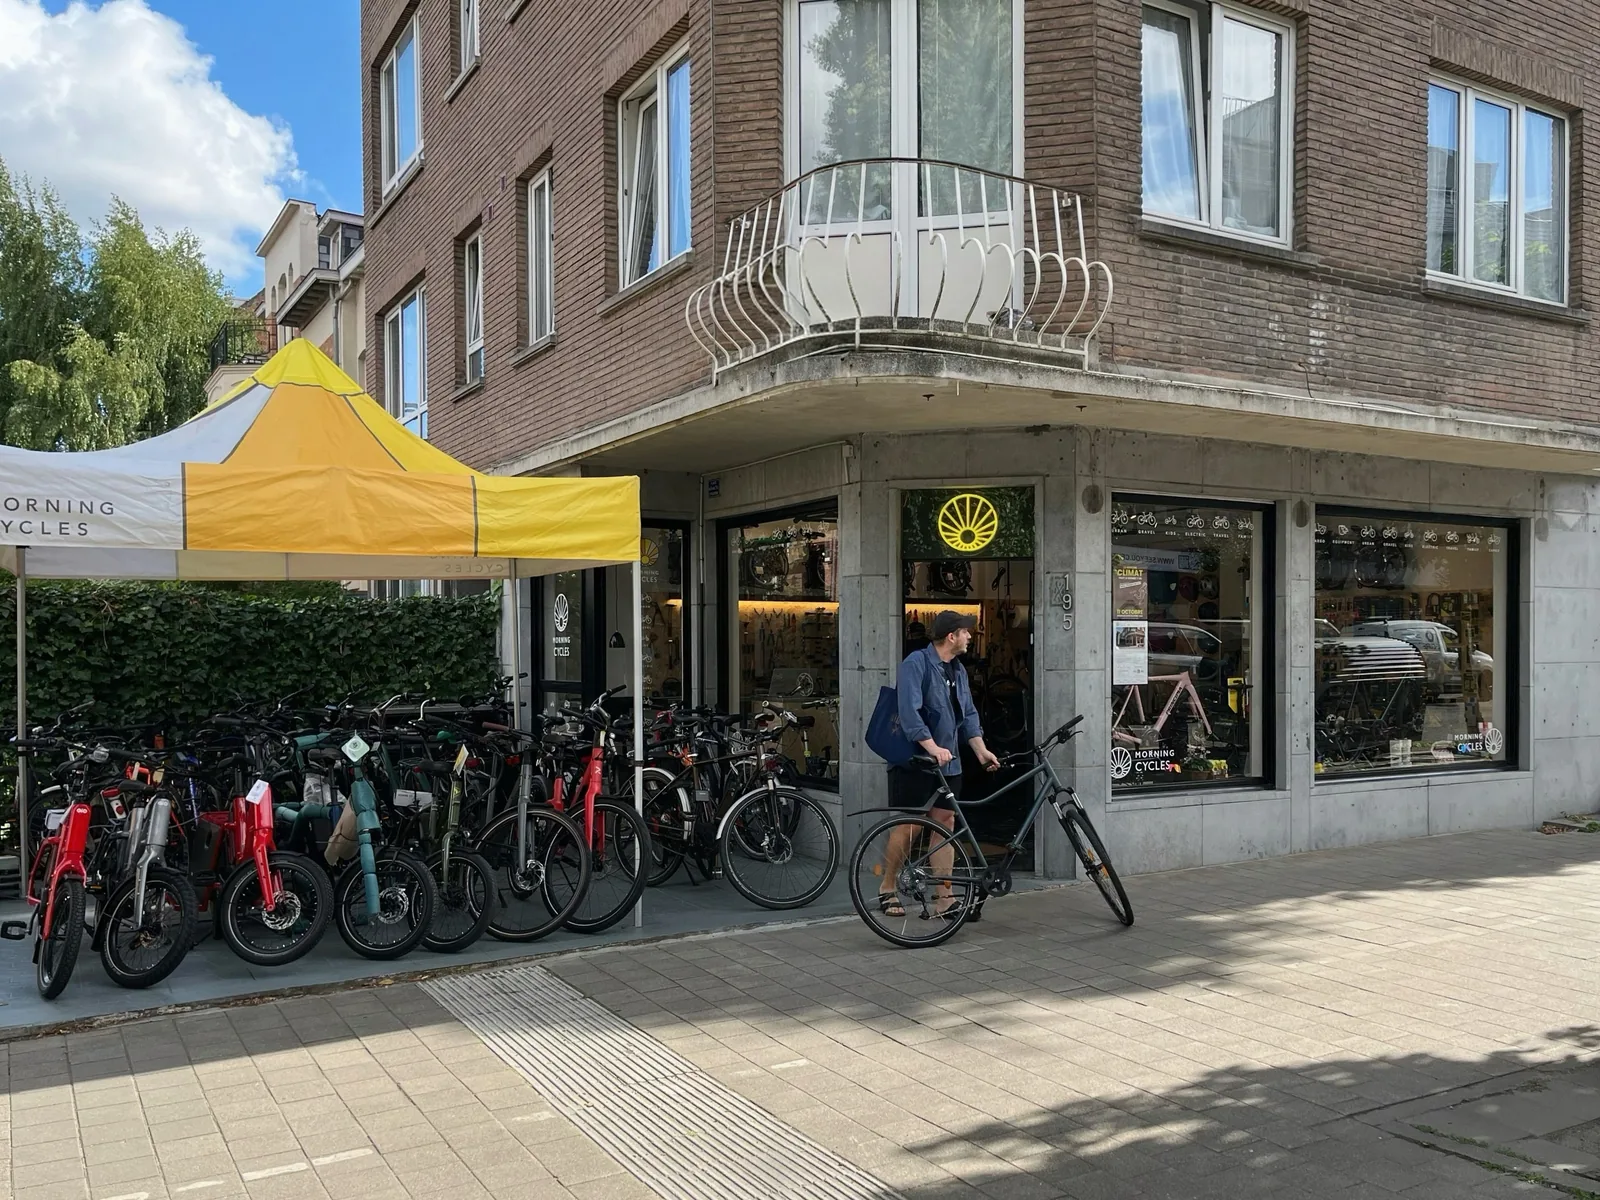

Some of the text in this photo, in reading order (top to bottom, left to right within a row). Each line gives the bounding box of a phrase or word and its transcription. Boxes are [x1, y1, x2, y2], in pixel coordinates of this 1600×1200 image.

[3, 497, 115, 515] ORNING
[0, 520, 88, 536] YCLES
[1117, 569, 1144, 577] CLIMAT
[552, 636, 571, 644] MORNING
[553, 646, 570, 657] CYCLES
[1134, 749, 1175, 759] MORNING
[1134, 760, 1171, 772] CYCLES
